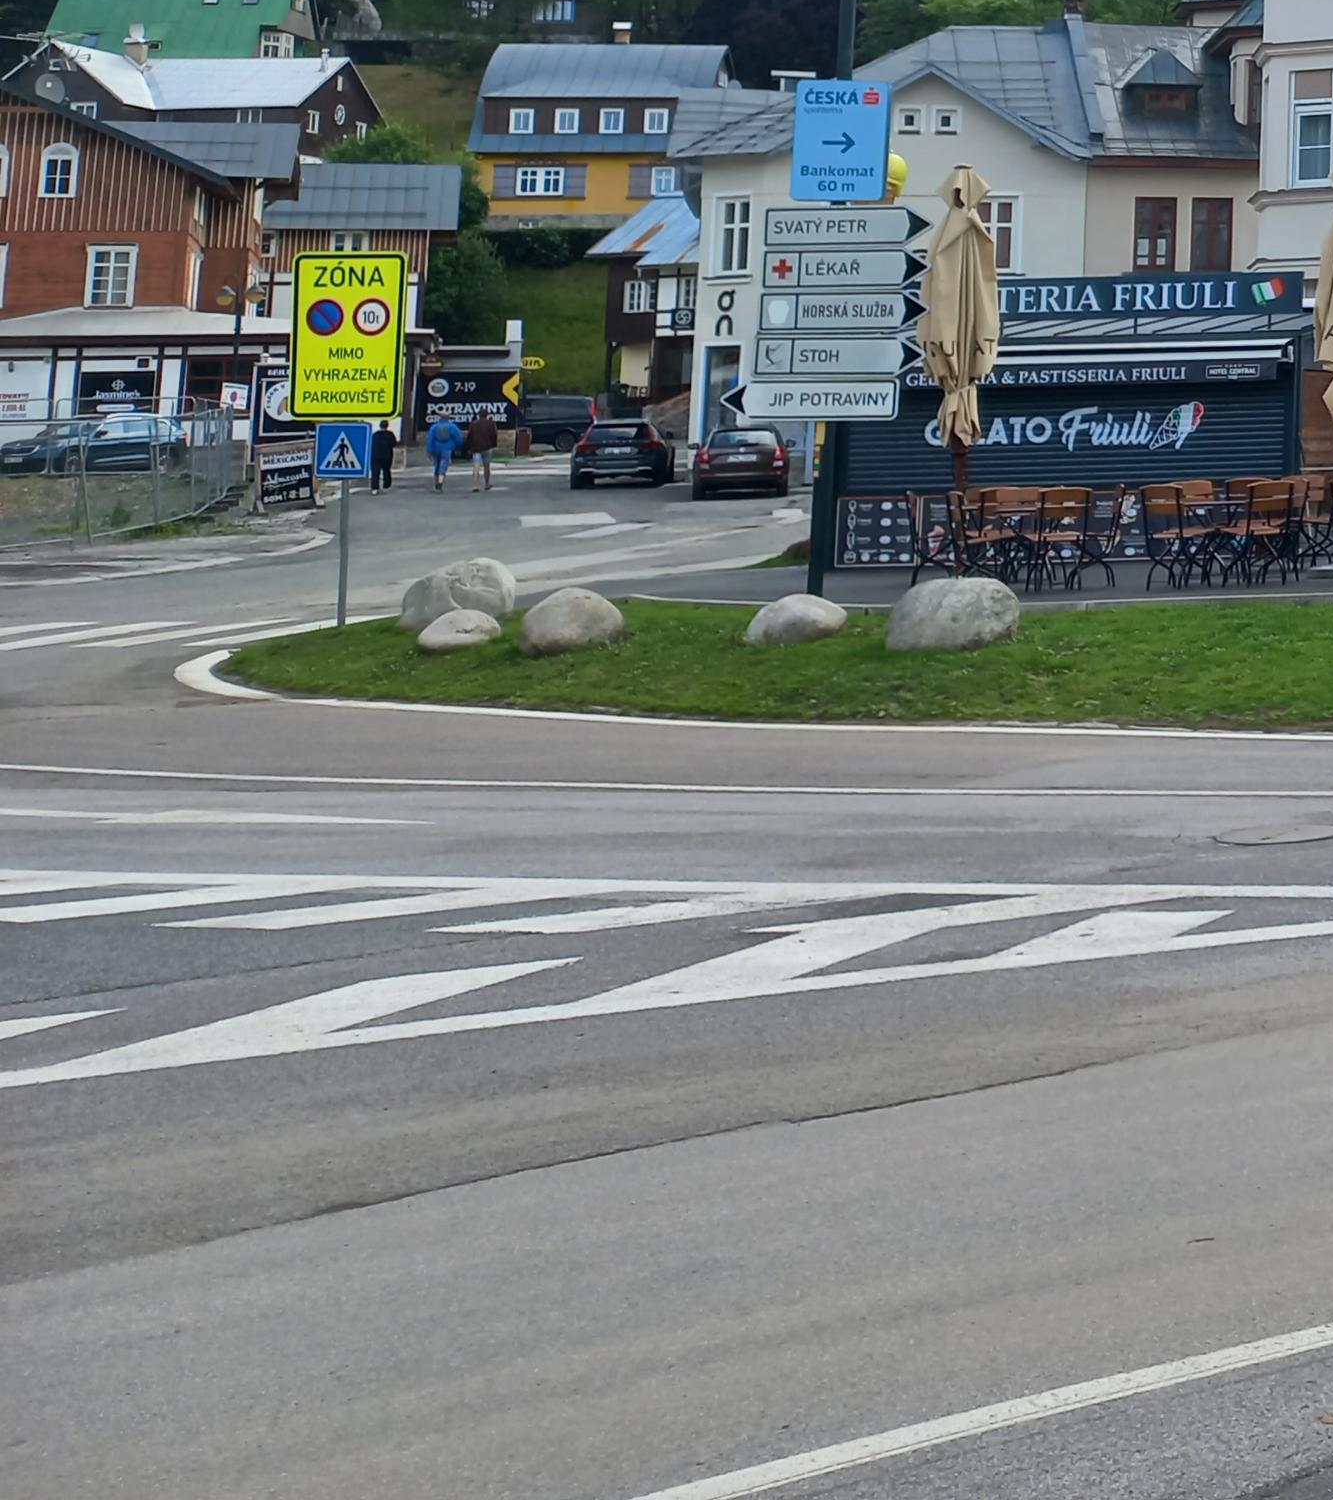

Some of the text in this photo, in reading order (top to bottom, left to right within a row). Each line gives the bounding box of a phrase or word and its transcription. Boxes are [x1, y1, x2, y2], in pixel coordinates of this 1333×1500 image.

[804, 88, 859, 105] ČESKÁ
[800, 165, 875, 177] Bankomat
[817, 180, 855, 192] 60 m
[773, 217, 867, 235] SVATÝ PETR
[313, 261, 385, 288] ZÓNA
[805, 259, 861, 276] LÉKAŘ
[999, 280, 1237, 314] TERIA FRIULI
[802, 301, 894, 319] HORSKÁ SLUŽBA
[328, 347, 364, 360] MIMO
[799, 349, 840, 363] STOH
[303, 365, 388, 381] VYHRAZENÁ
[1001, 370, 1016, 385] &
[1018, 368, 1127, 385] PASTISSERIA
[1131, 366, 1187, 382] FRIULI
[454, 381, 476, 393] 7-19
[302, 388, 386, 404] PARKOVIŠTĚ
[768, 392, 889, 407] JIP POTRAVINY
[427, 402, 508, 414] POTRAVINY
[924, 405, 1152, 452] GATO Friuli
